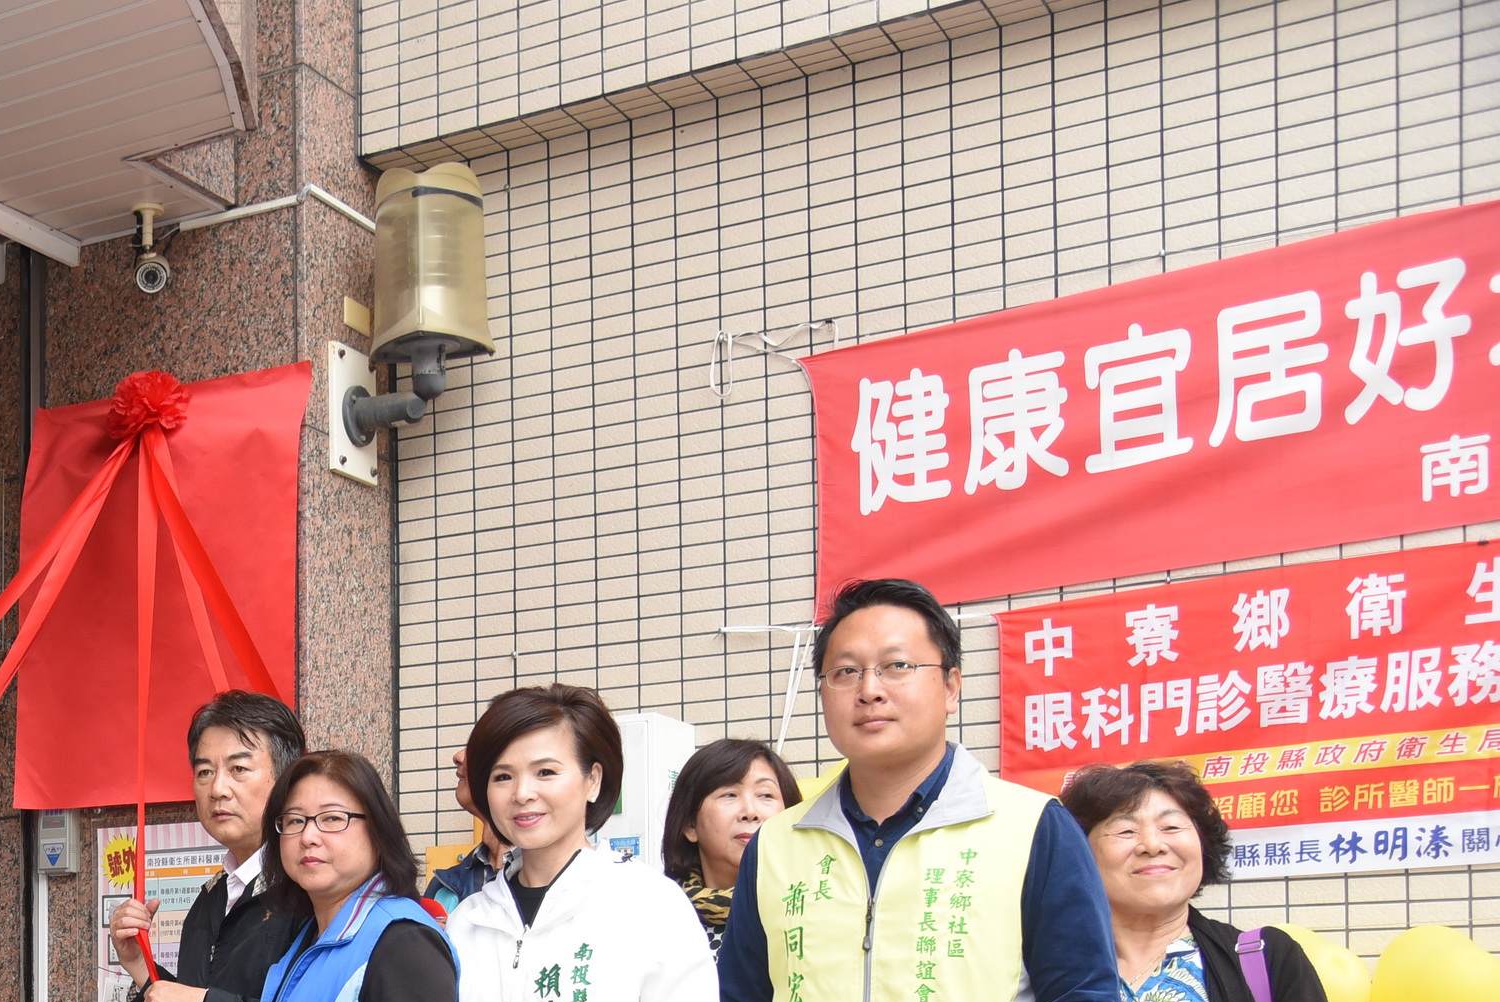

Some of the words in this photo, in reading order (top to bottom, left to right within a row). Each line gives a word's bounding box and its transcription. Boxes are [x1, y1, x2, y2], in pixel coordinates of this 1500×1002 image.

[850, 257, 1500, 516] 健康宜居好
[1420, 434, 1491, 502] 南
[1024, 640, 1500, 752] 眼科門診醫療服務
[1202, 728, 1500, 779] 南投縣政府衛生局
[106, 845, 137, 878] 號外
[813, 854, 837, 902] 會長
[1223, 838, 1323, 868] 縣縣長
[947, 848, 978, 959] 中寮鄉社區
